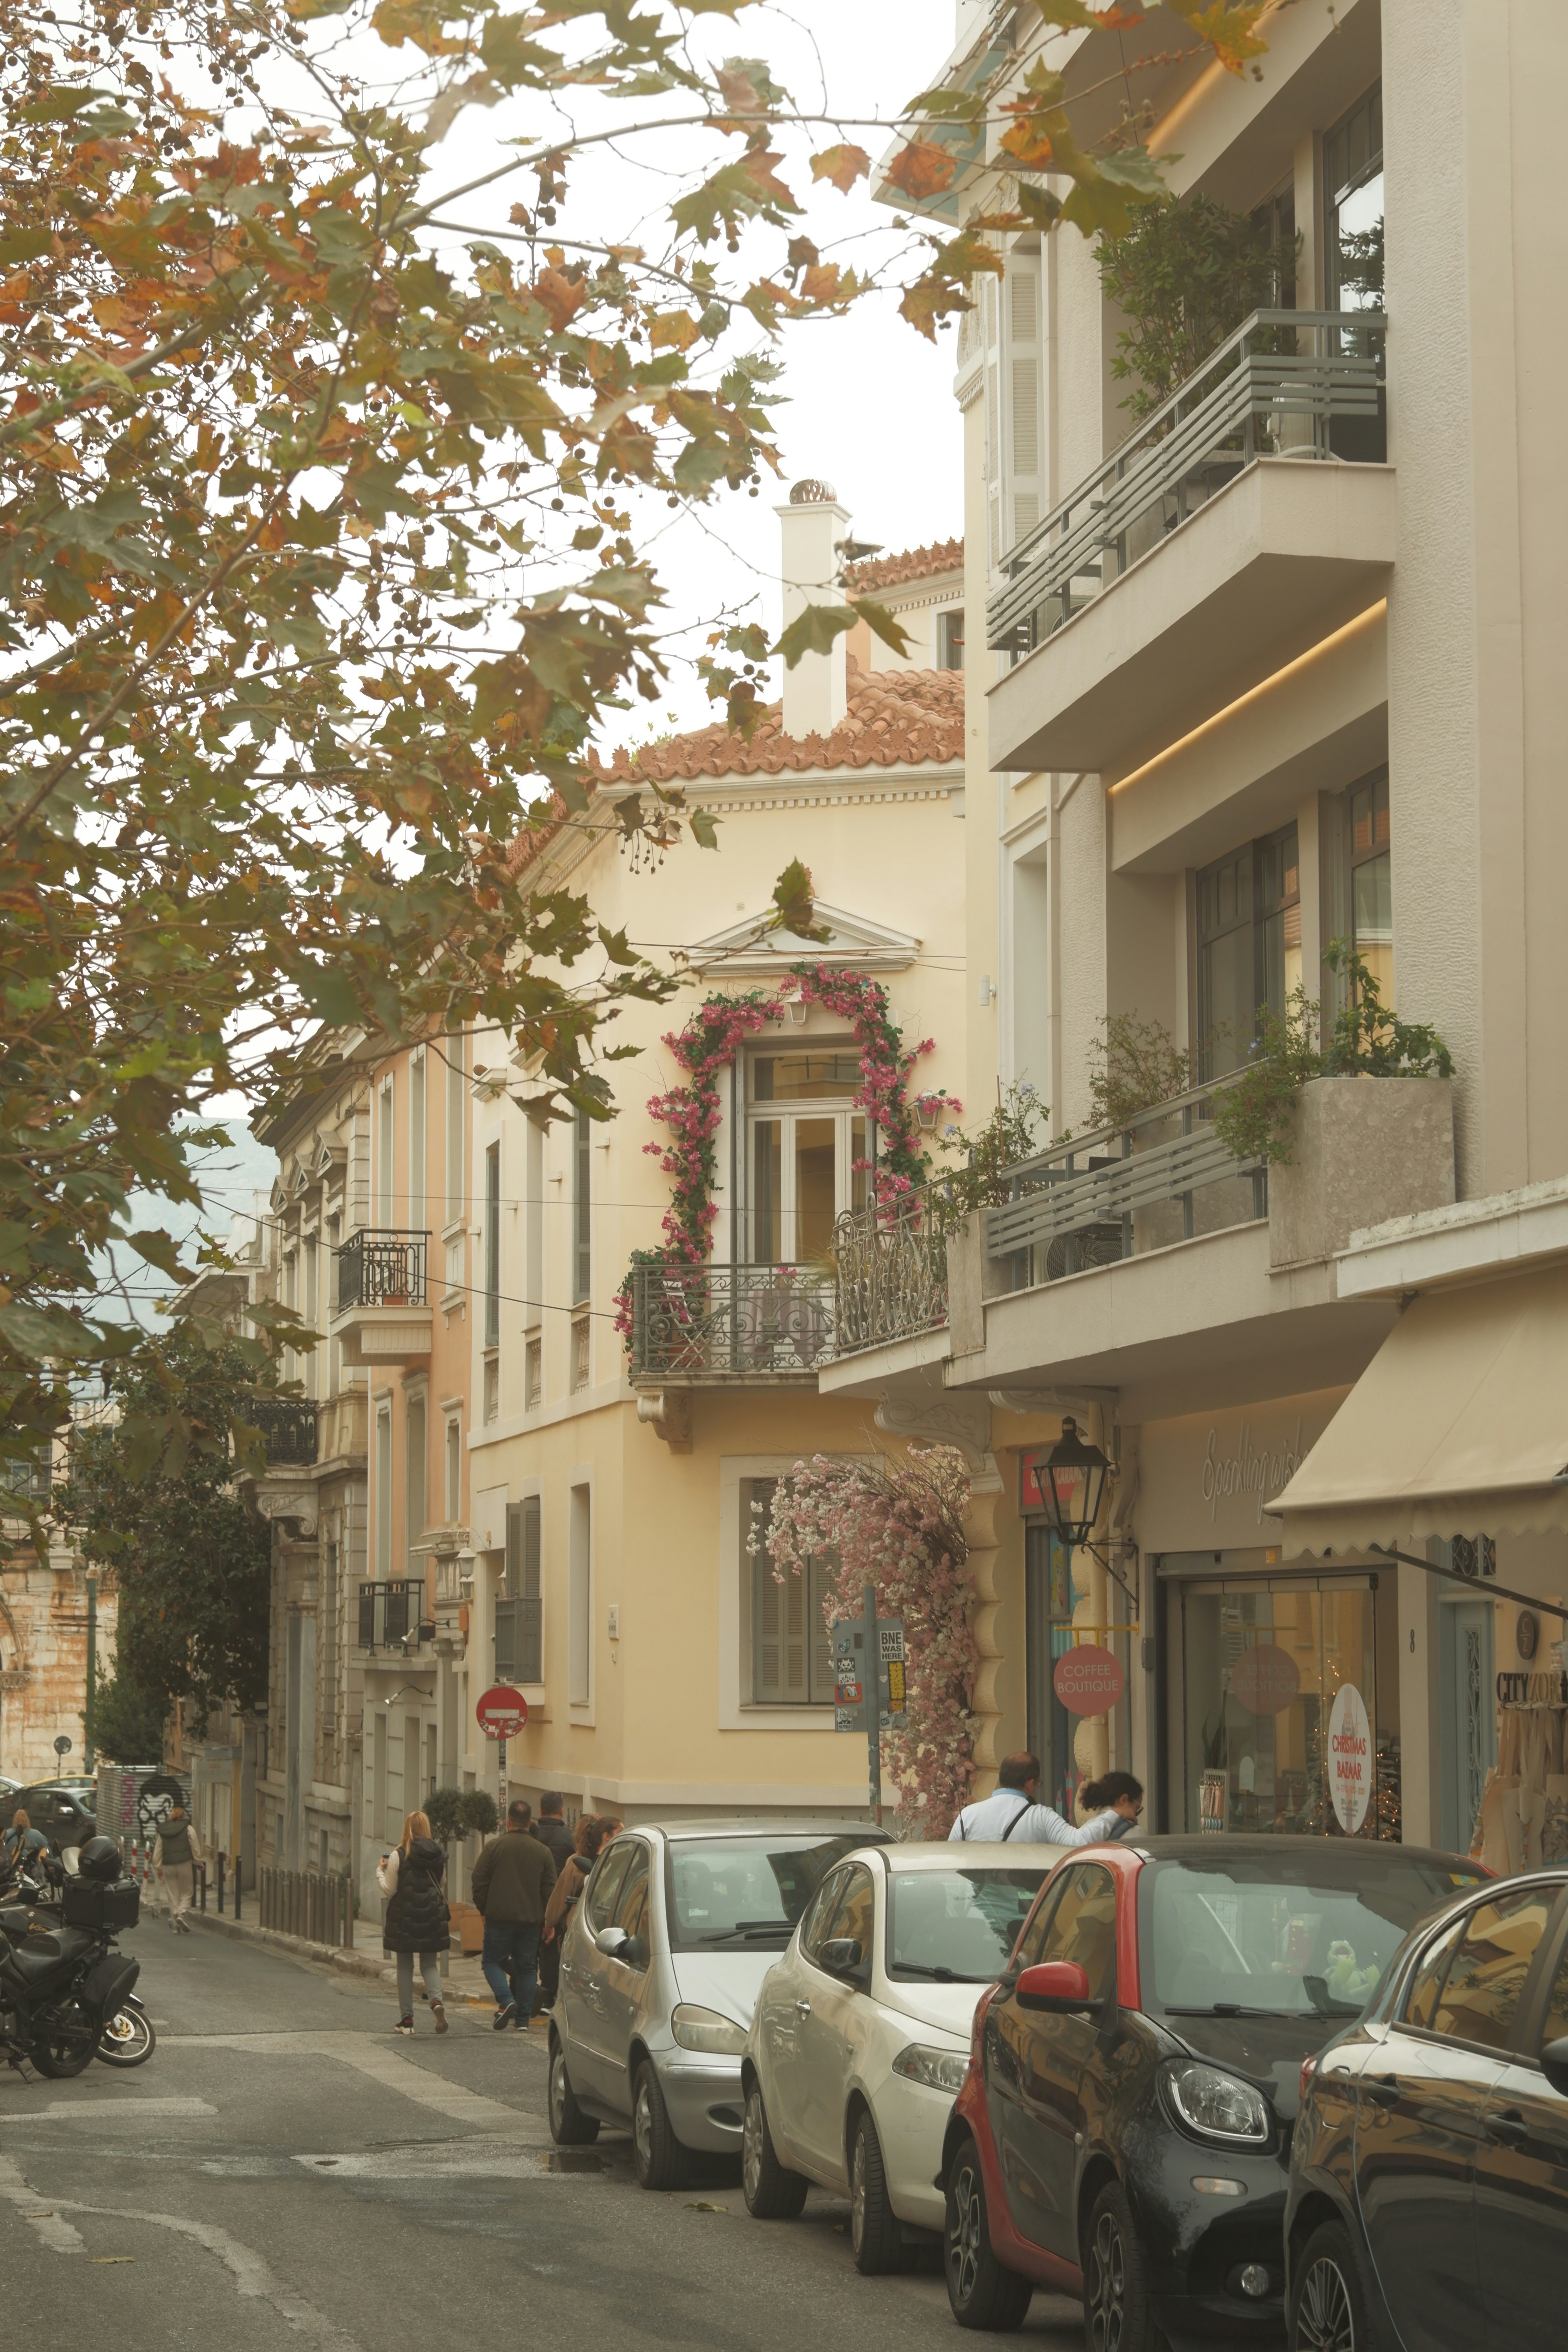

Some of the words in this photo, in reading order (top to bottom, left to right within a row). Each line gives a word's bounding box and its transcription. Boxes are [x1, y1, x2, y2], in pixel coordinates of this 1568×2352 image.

[1203, 1418, 1269, 1524] Sparkling
[1522, 1618, 1528, 1633] C
[881, 1632, 902, 1644] BNE
[1410, 1629, 1415, 1653] 8
[1522, 1637, 1528, 1652] Z
[1063, 1664, 1111, 1677] COFFEE
[840, 1674, 855, 1684] 2FACE
[1057, 1680, 1118, 1693] BOUTIQUE
[1332, 1734, 1366, 1756] CHRISTMAS
[1337, 1760, 1362, 1780] BAZAAR
